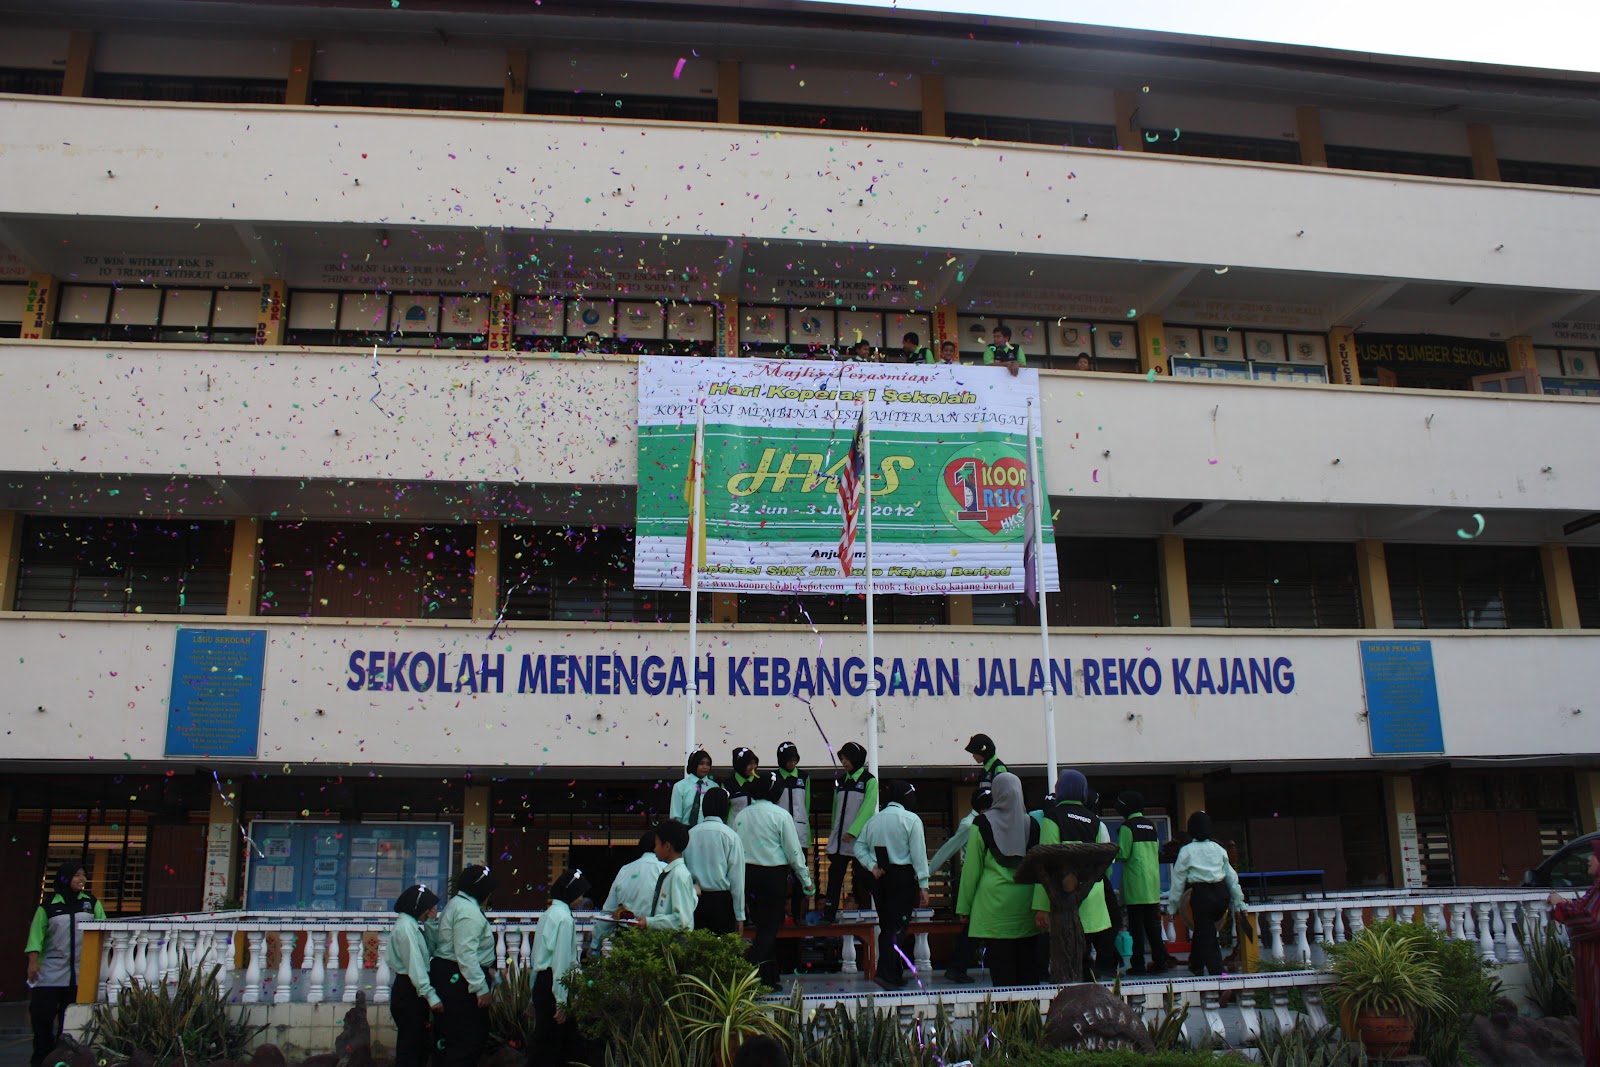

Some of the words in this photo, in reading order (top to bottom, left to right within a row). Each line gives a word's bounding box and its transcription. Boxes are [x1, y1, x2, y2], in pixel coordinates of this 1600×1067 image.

[83, 256, 98, 265] TO
[104, 257, 124, 266] WIN
[129, 257, 174, 267] WITHOUT
[217, 270, 251, 280] GLORY
[26, 281, 39, 312] HAVE
[260, 284, 271, 313] DONT
[270, 291, 280, 320] LOOK
[34, 289, 48, 328] FAITH
[1152, 337, 1162, 356] BE
[1396, 344, 1450, 363] SUMBER
[1452, 348, 1507, 368] SEKOLAH
[744, 361, 826, 381] Majlis
[1339, 343, 1352, 385] SUCCE
[709, 382, 762, 398] Hari
[766, 385, 876, 402] Koperasi
[882, 388, 977, 405] Sekolah
[737, 405, 818, 419] MEMBINA
[822, 408, 958, 424] KESEAHTERAAN
[954, 461, 988, 522] 1
[729, 502, 750, 514] 22
[755, 504, 788, 515] Jun
[805, 504, 816, 515] 3
[872, 505, 915, 517] 2012
[1000, 512, 1025, 530] HKS
[699, 565, 762, 576] operasi
[766, 565, 808, 576] SMK
[809, 565, 836, 576] Jln
[887, 566, 947, 579] Kajang
[951, 566, 1012, 577] Berhad
[855, 582, 896, 591] facbook
[904, 582, 947, 592] koopreko
[949, 582, 980, 592] kajang
[983, 582, 1015, 591] berhad
[215, 636, 251, 644] SEKOLAH
[346, 649, 505, 693] SEKOLAH
[517, 653, 716, 696] MENENGAH
[727, 656, 961, 698] KEBANGSAAN
[973, 657, 1073, 696] JALAN
[1083, 656, 1163, 696] REKO
[1171, 656, 1297, 696] KAJANG
